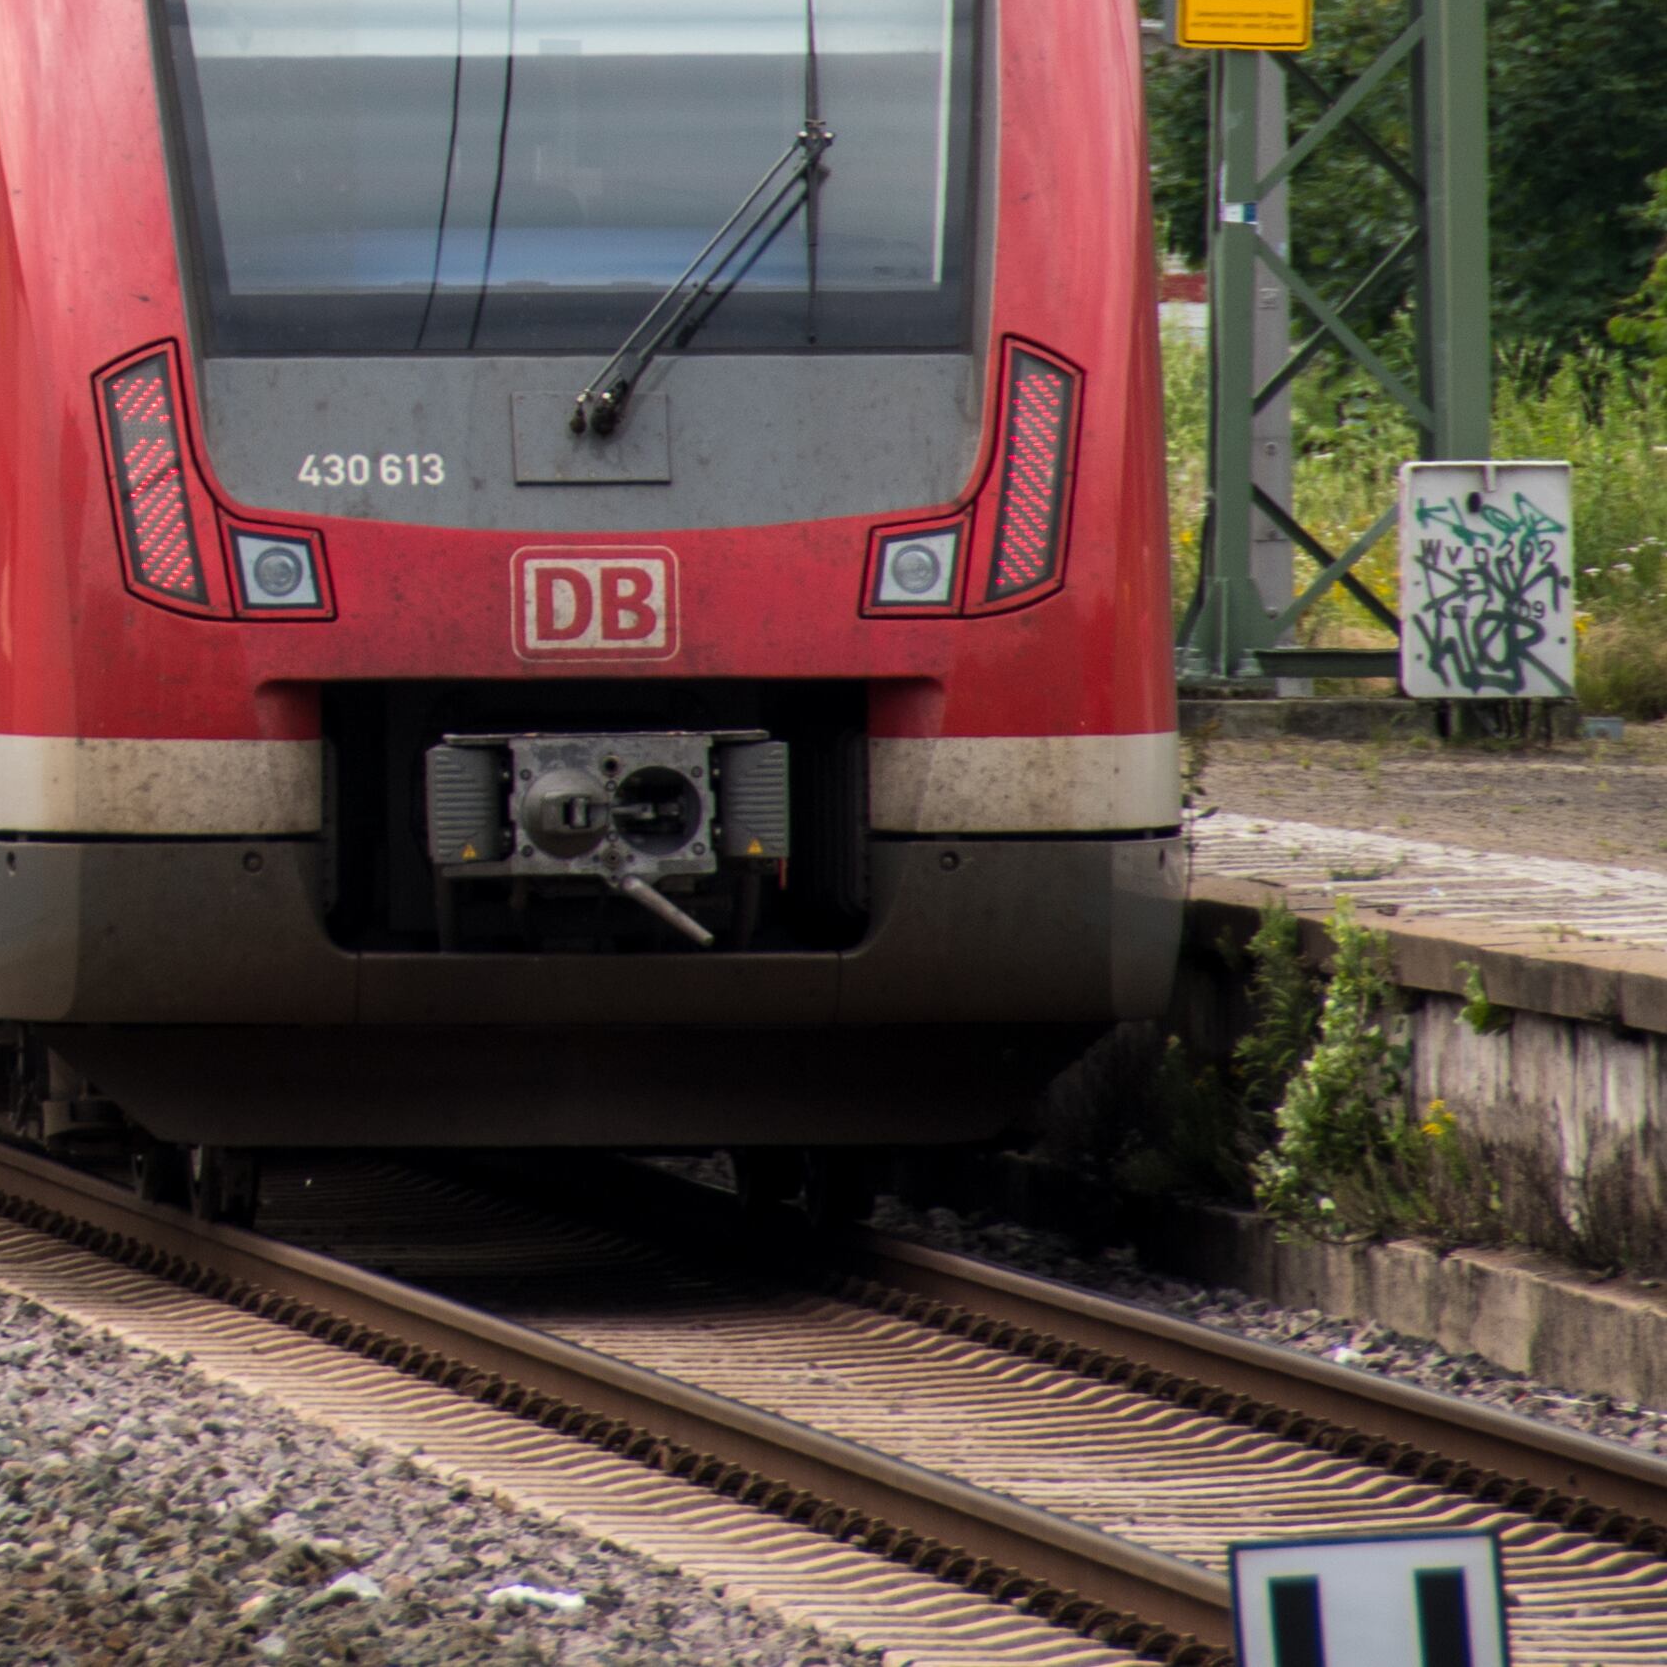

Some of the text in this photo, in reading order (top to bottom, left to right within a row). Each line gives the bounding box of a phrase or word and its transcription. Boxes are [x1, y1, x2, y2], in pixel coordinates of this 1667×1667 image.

[298, 453, 446, 486] 430 613
[535, 567, 657, 641] DB
